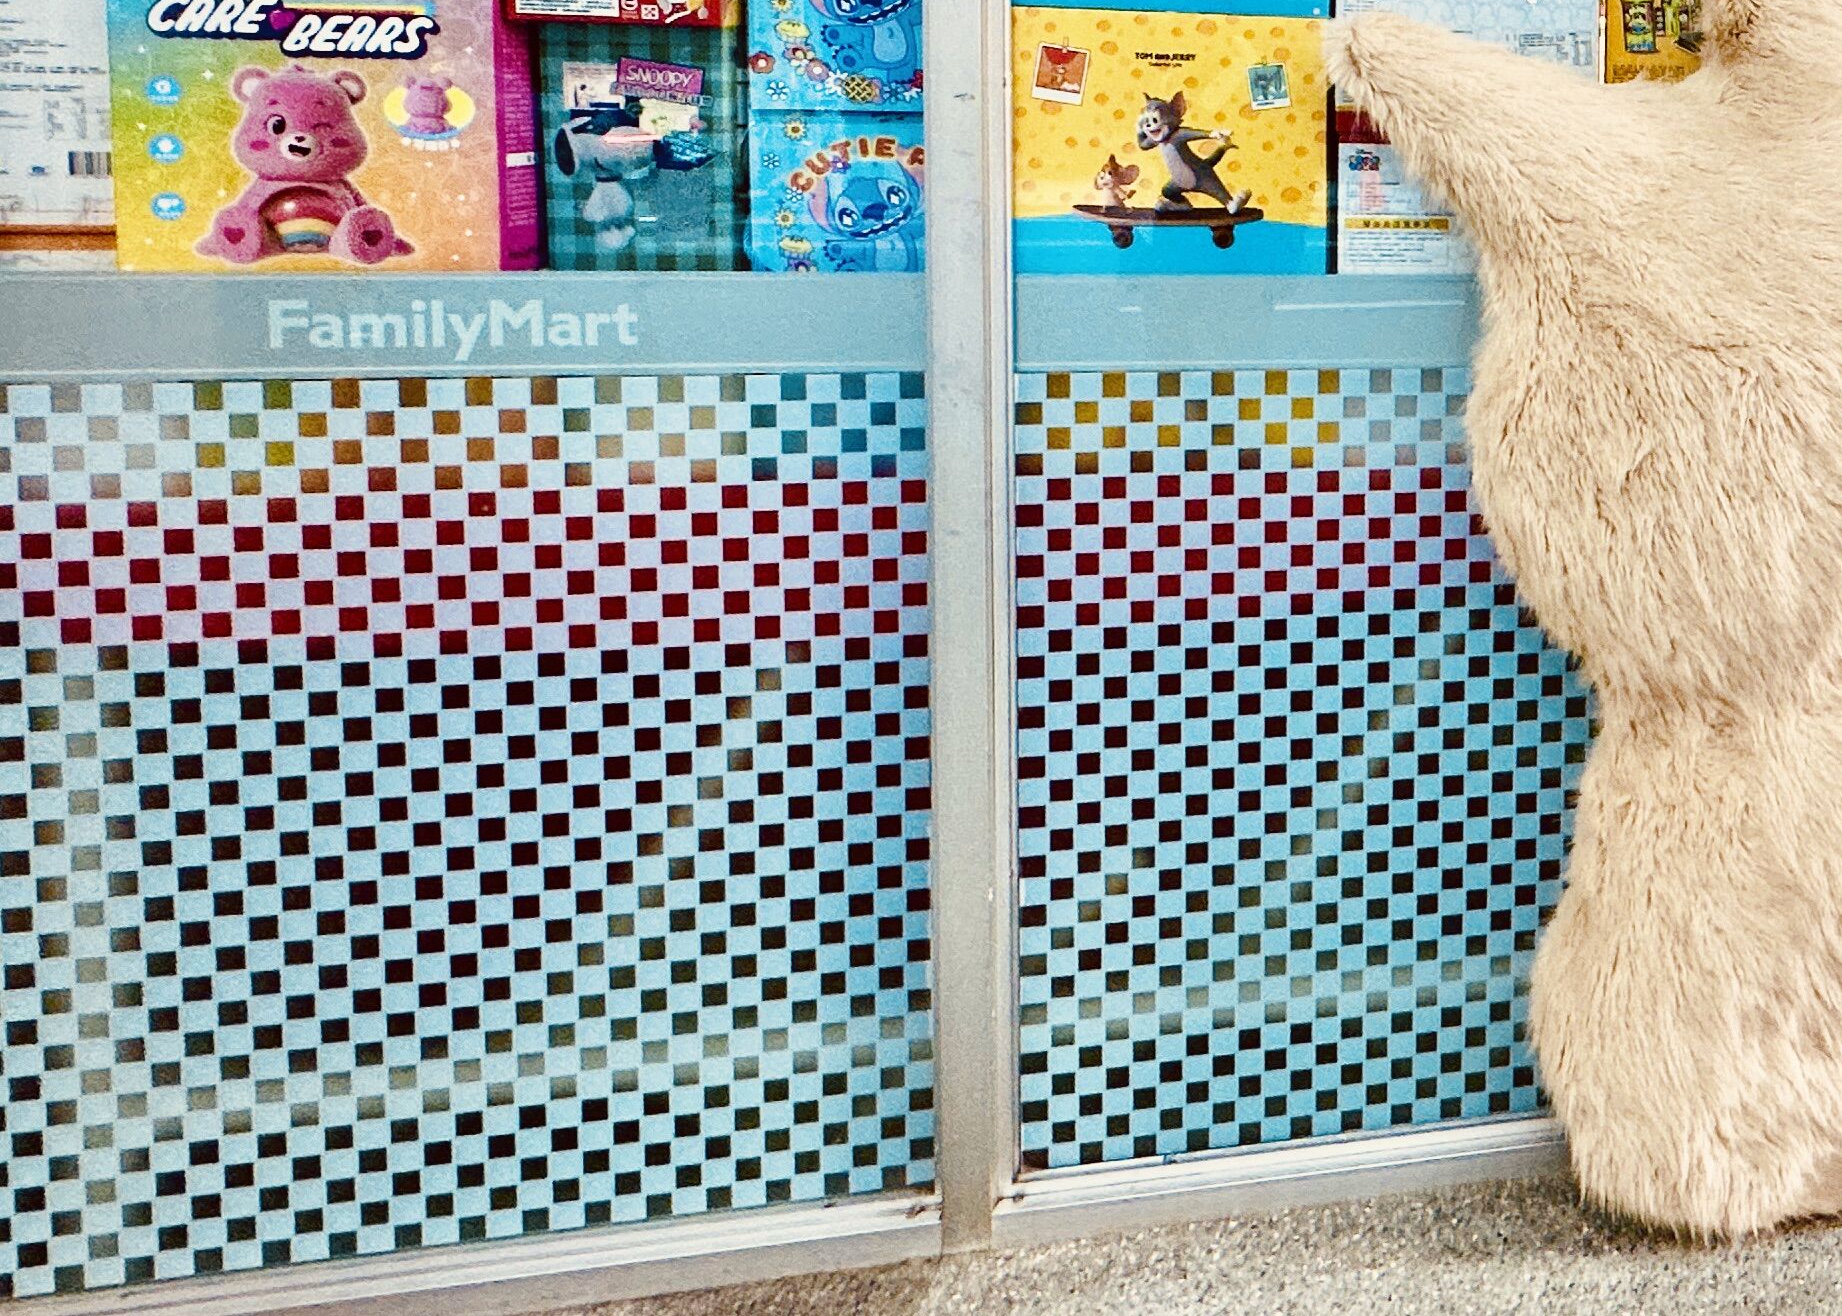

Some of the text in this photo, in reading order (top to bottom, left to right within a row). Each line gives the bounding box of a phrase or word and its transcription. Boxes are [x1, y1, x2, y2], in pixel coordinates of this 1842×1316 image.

[284, 13, 435, 56] BEARS
[625, 64, 695, 88] SNOOPY
[790, 137, 897, 191] CUTIE
[268, 299, 639, 362] FamilyMart
